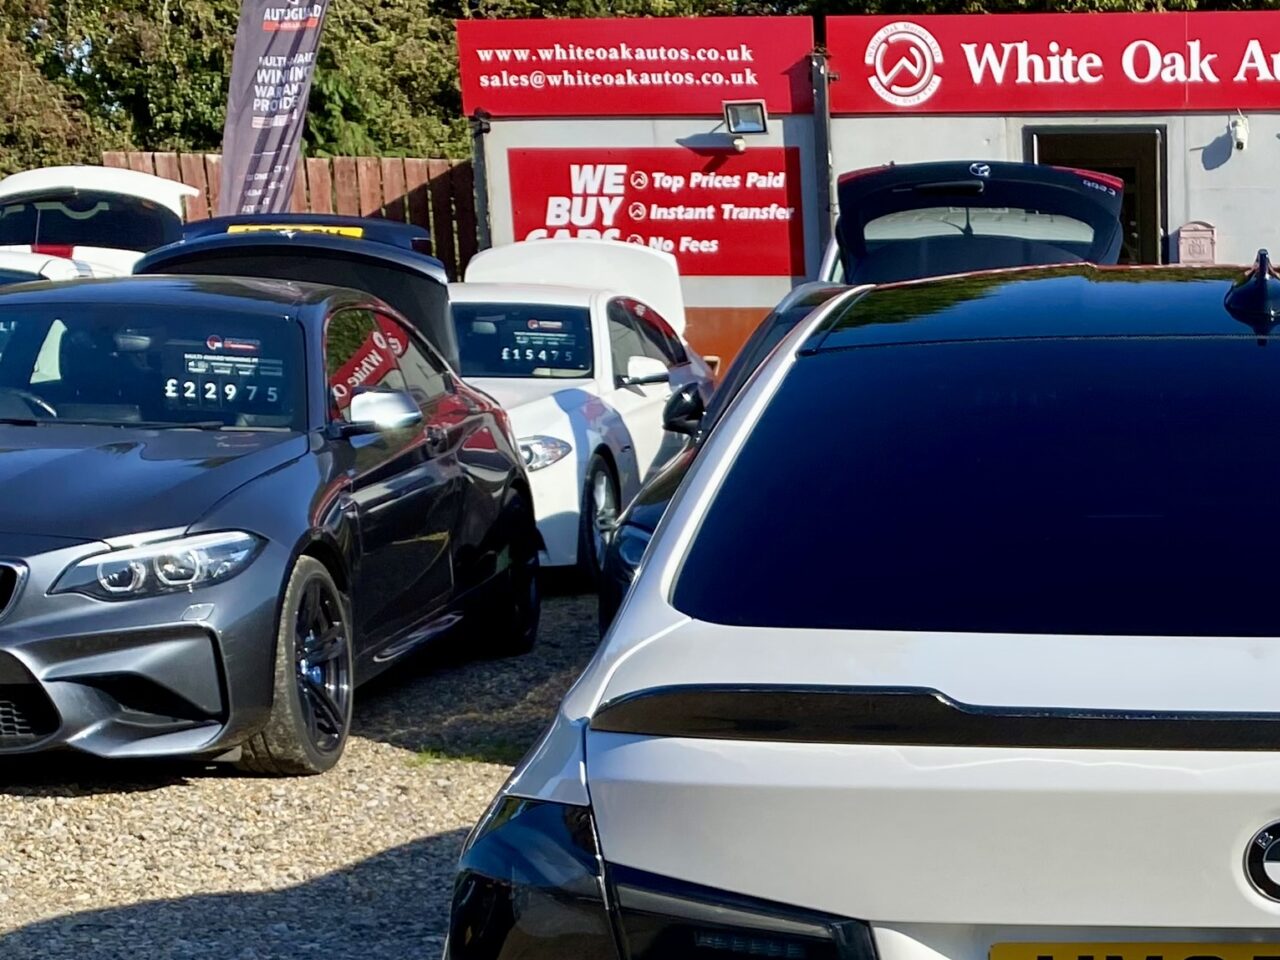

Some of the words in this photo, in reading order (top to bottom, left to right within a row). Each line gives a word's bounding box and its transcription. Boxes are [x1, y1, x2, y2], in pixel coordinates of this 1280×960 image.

[476, 43, 753, 62] www.whiteoakautos.co.uk
[961, 40, 1104, 85] White
[1121, 39, 1219, 84] Oak
[479, 68, 758, 88] sales@whiteoakautos.co.uk
[570, 164, 627, 195] WE
[652, 172, 684, 192] Top
[690, 172, 740, 189] Prices
[746, 172, 785, 188] Paid
[545, 196, 624, 226] BUY
[650, 204, 715, 220] Instant
[721, 204, 794, 220] Transfer
[649, 236, 674, 252] No
[679, 237, 719, 252] Fees
[501, 347, 572, 361] £15475
[165, 378, 278, 402] £22975
